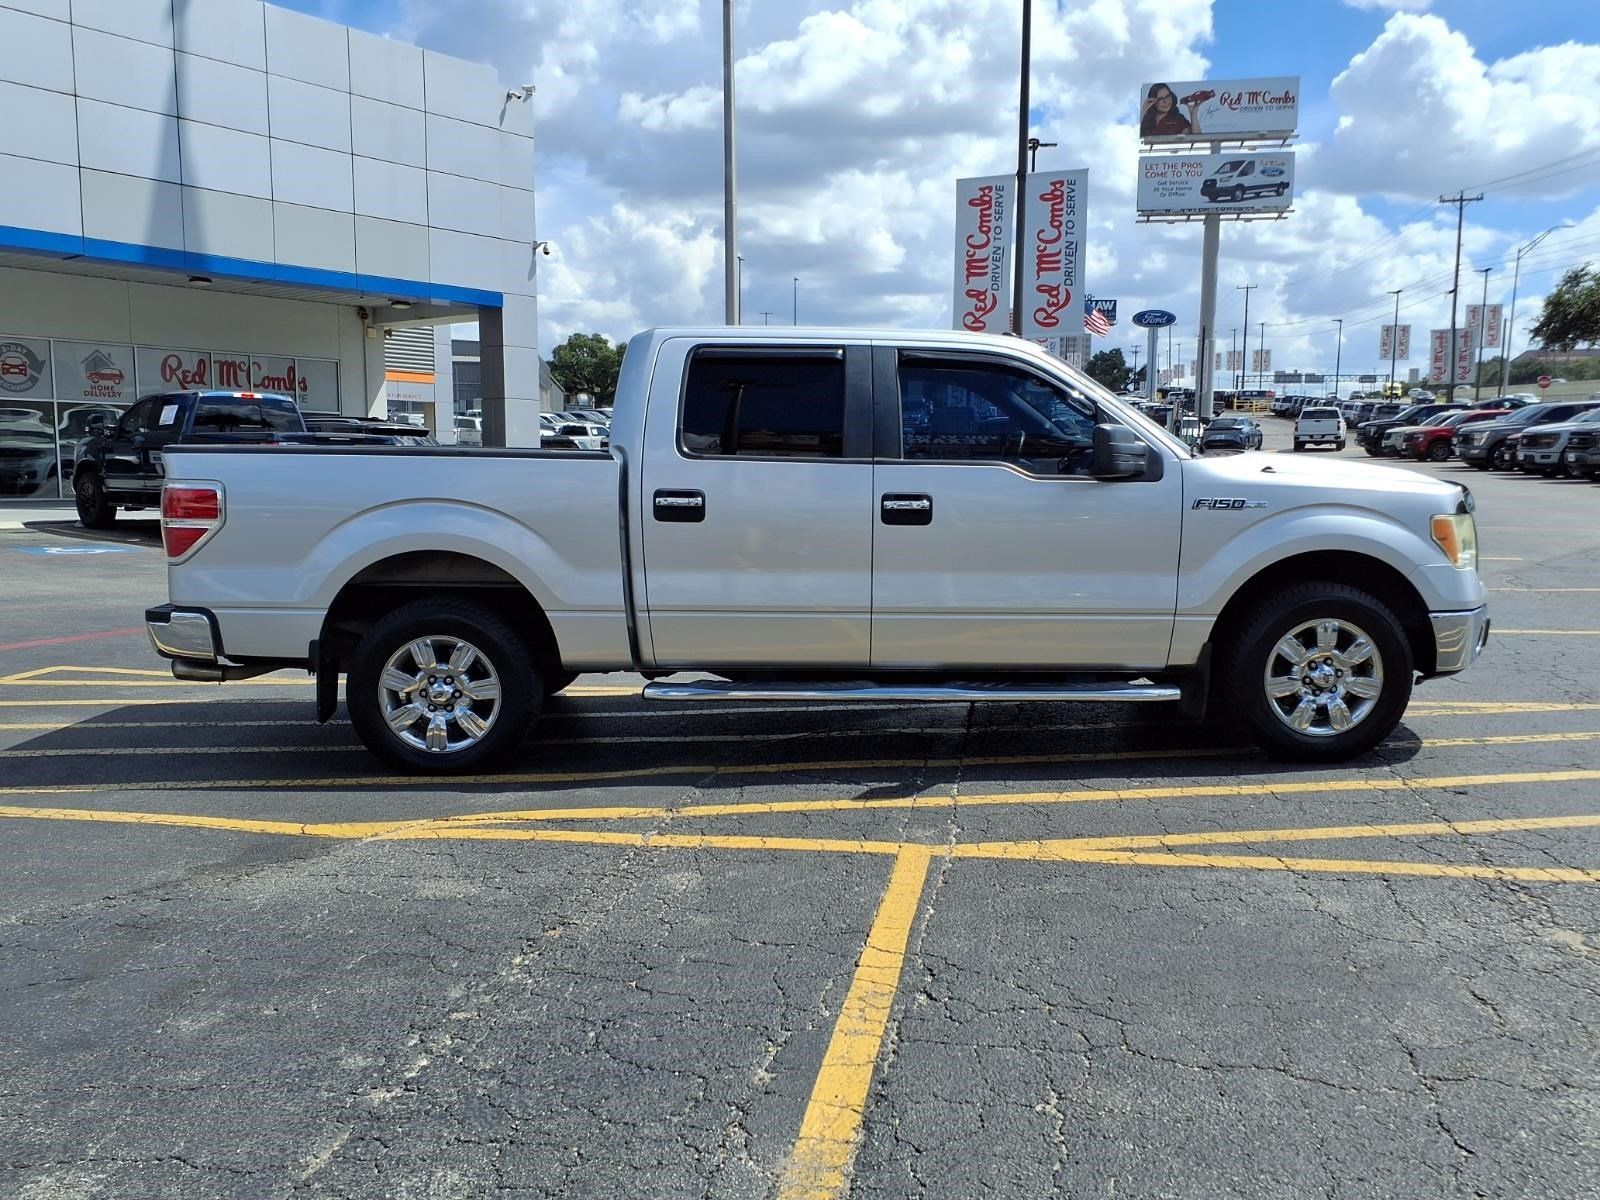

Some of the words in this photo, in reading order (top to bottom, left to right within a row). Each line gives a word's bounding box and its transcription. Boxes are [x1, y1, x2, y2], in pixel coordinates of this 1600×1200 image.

[1220, 91, 1243, 110] Red
[1244, 90, 1295, 105] McCombs
[1145, 163, 1160, 171] LET
[1162, 162, 1178, 170] THE
[1181, 161, 1203, 169] PROS
[994, 184, 1005, 223] SERVE
[1066, 179, 1076, 216] SERVE
[966, 185, 993, 285] McCombs
[994, 225, 1003, 242] TO
[1036, 179, 1064, 280] McCombs
[1066, 219, 1075, 237] TO
[991, 246, 1002, 291] DRIVEN
[1064, 241, 1074, 287] DRIVEN
[963, 288, 997, 332] Red
[1033, 284, 1071, 328] Red
[1142, 313, 1168, 324] Ford
[161, 354, 207, 390] Red
[84, 390, 122, 398] DELIVERY
[1192, 497, 1247, 510] F-150
